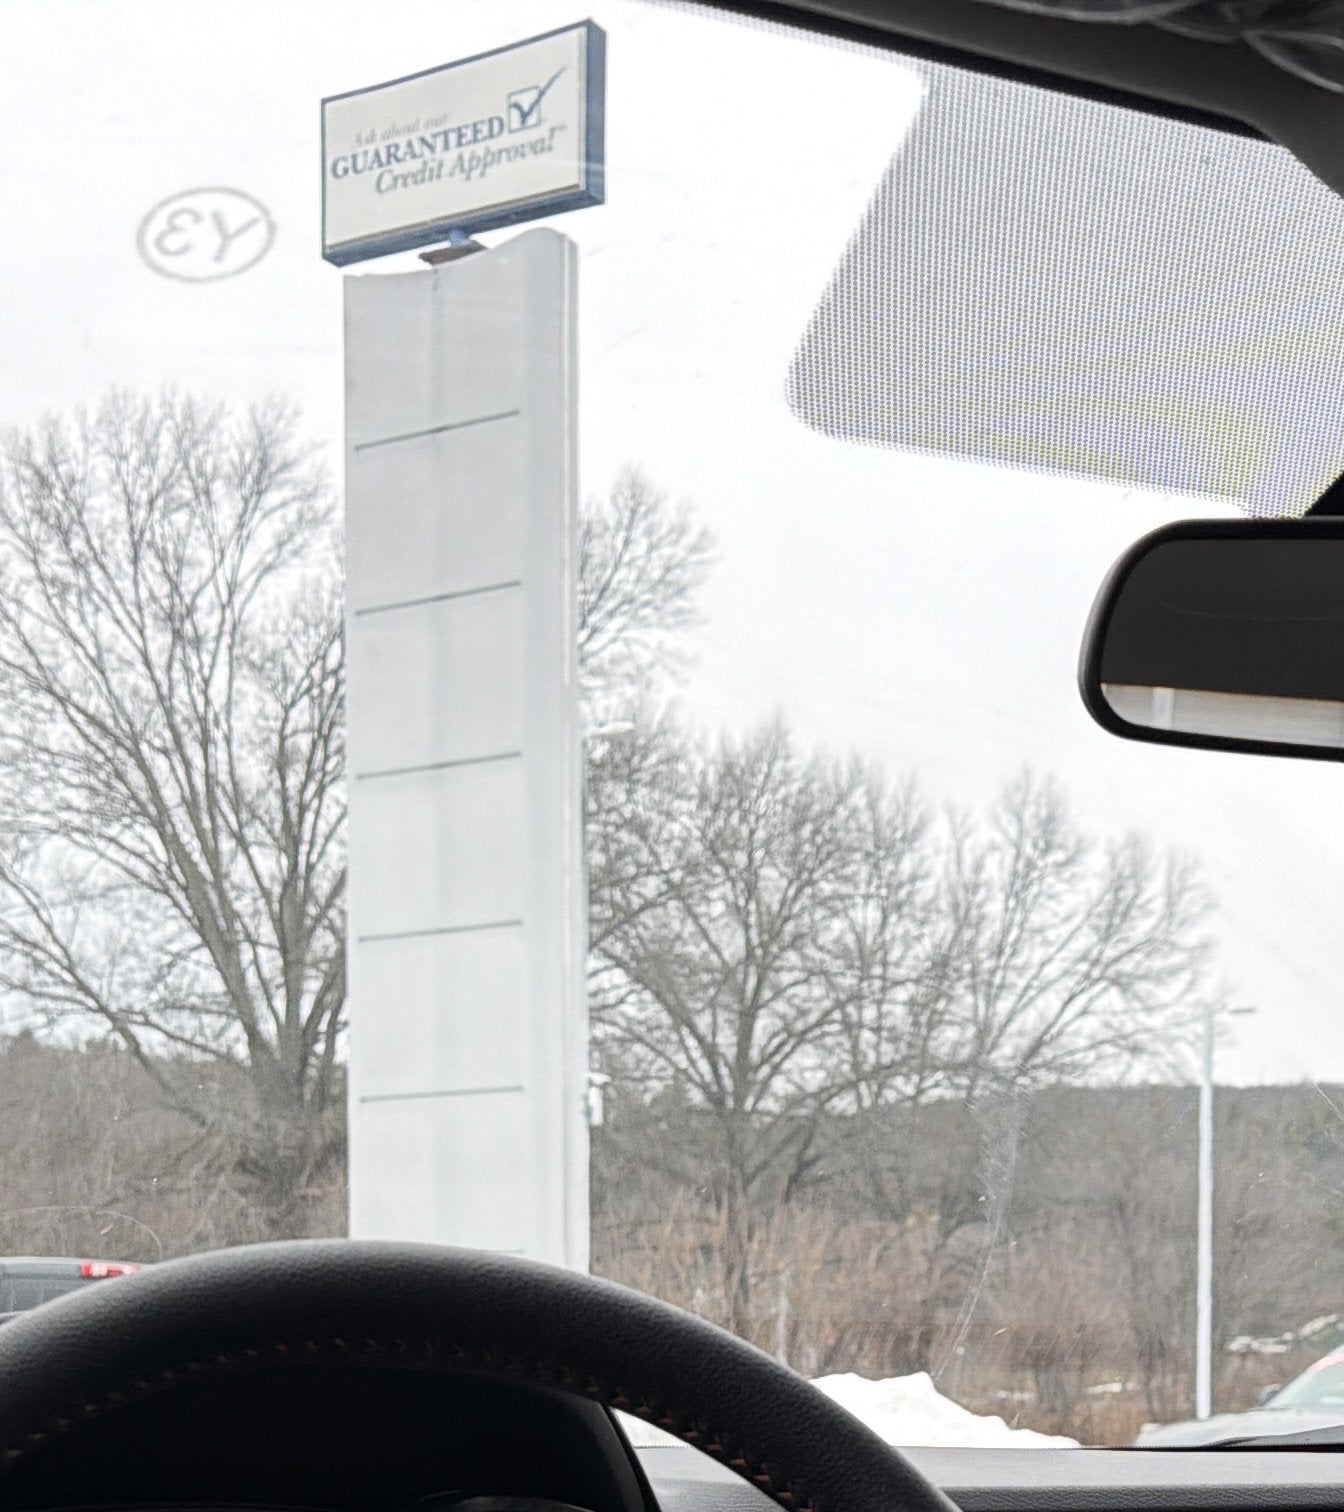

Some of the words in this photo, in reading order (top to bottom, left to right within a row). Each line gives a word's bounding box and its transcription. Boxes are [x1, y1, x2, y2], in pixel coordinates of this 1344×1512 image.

[331, 115, 505, 180] GUARANTEED
[376, 158, 444, 194] Credit
[448, 126, 556, 182] Approval
